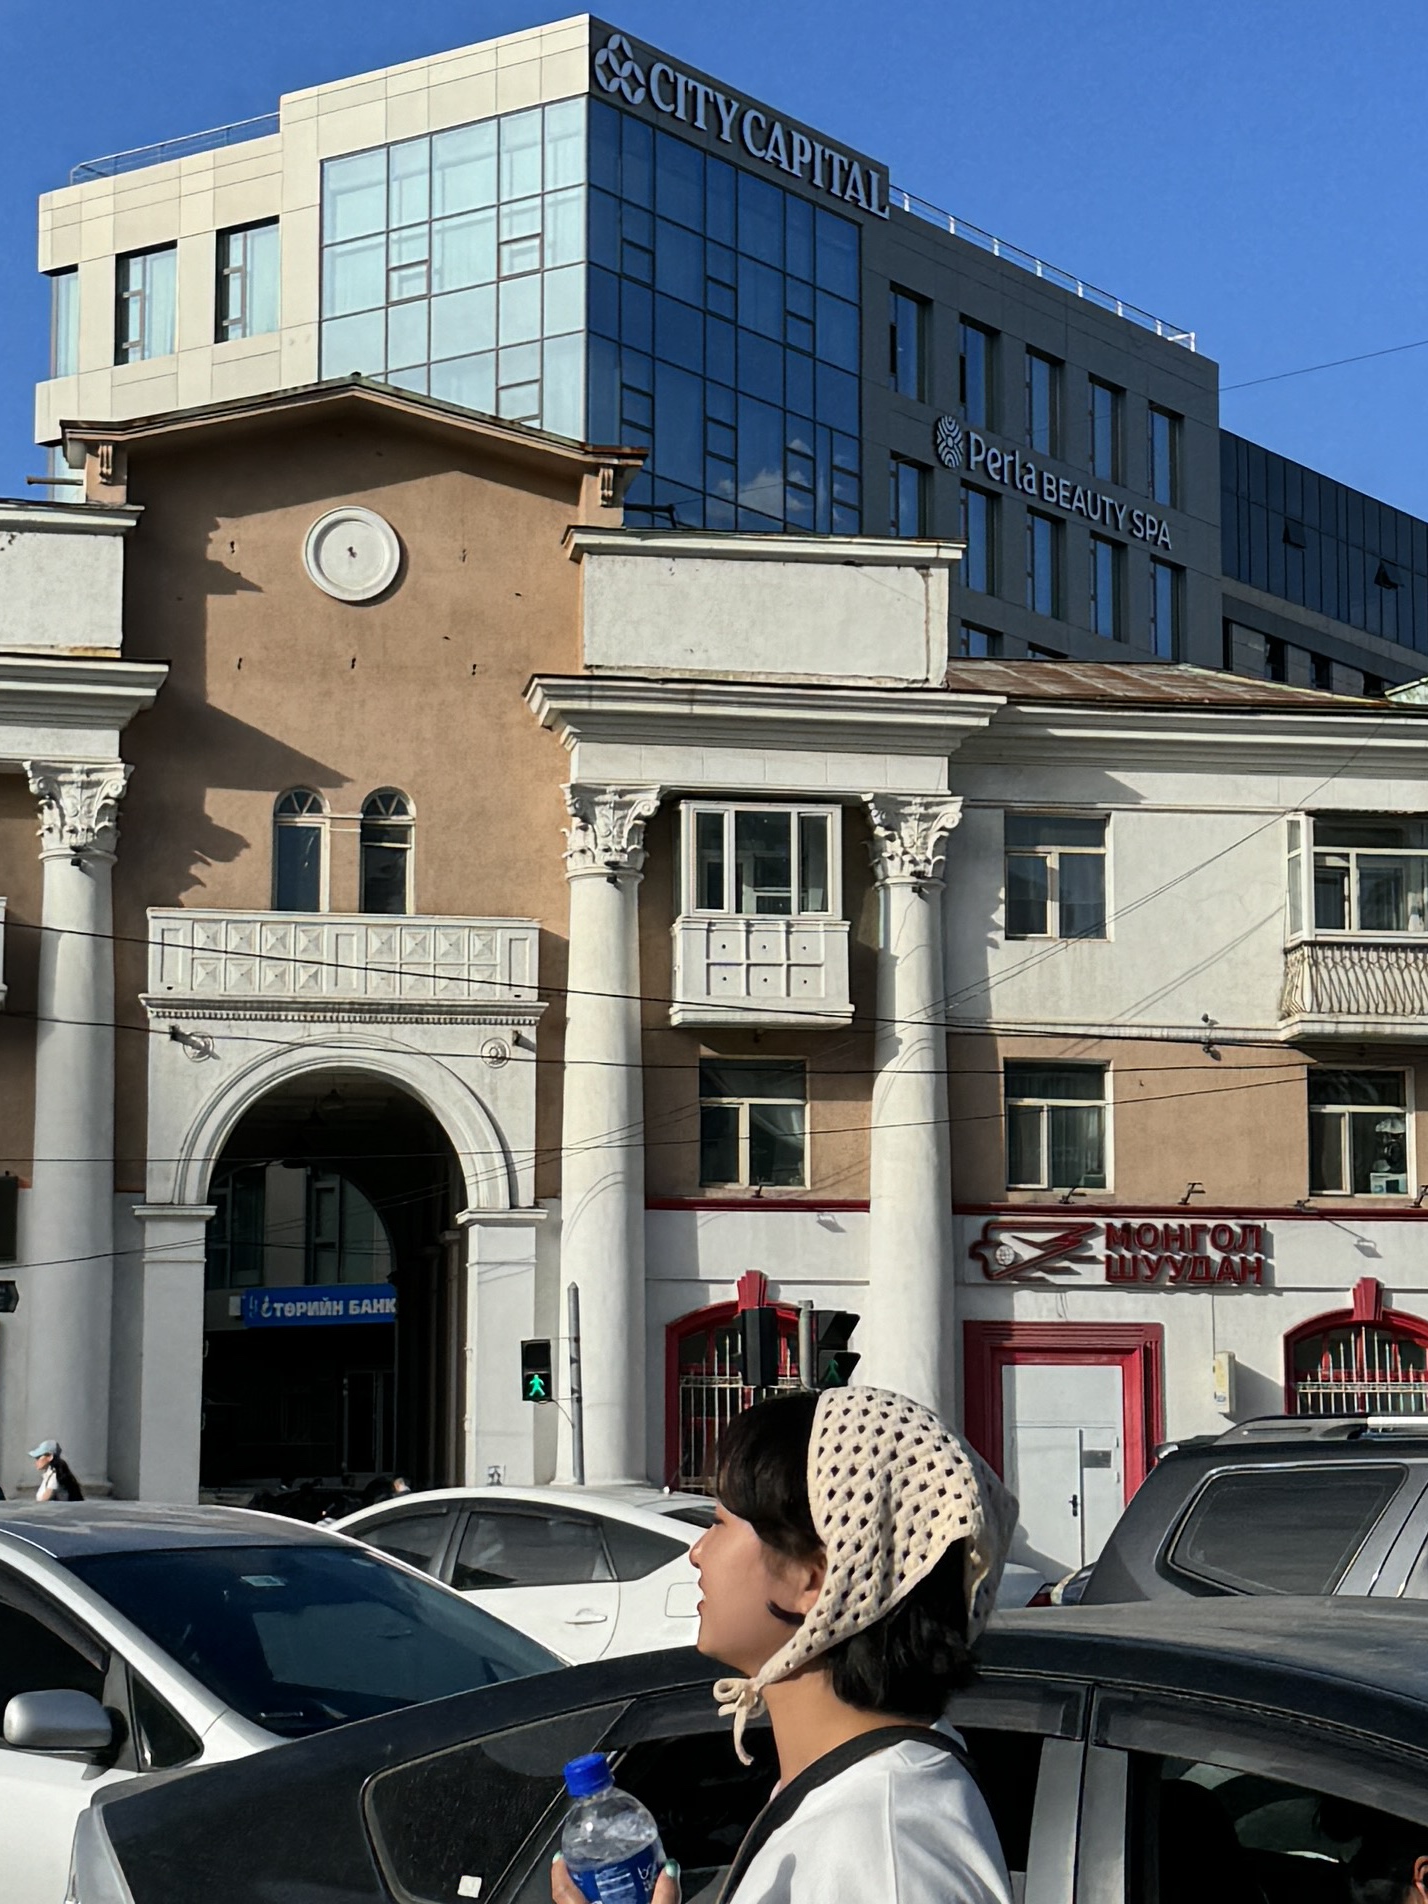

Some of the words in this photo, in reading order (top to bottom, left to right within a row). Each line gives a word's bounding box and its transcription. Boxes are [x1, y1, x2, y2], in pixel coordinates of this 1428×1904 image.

[650, 62, 740, 143] CITY
[742, 109, 890, 220] CAPITAL
[968, 431, 1038, 495] Perla
[1042, 471, 1127, 532] BEAUTY
[1132, 508, 1172, 550] SPA
[1104, 1222, 1263, 1252] МОНГОЛ
[1104, 1254, 1263, 1285] ШУУДАН
[273, 1297, 344, 1317] ТӨРИЙН
[349, 1298, 396, 1315] БАНК
